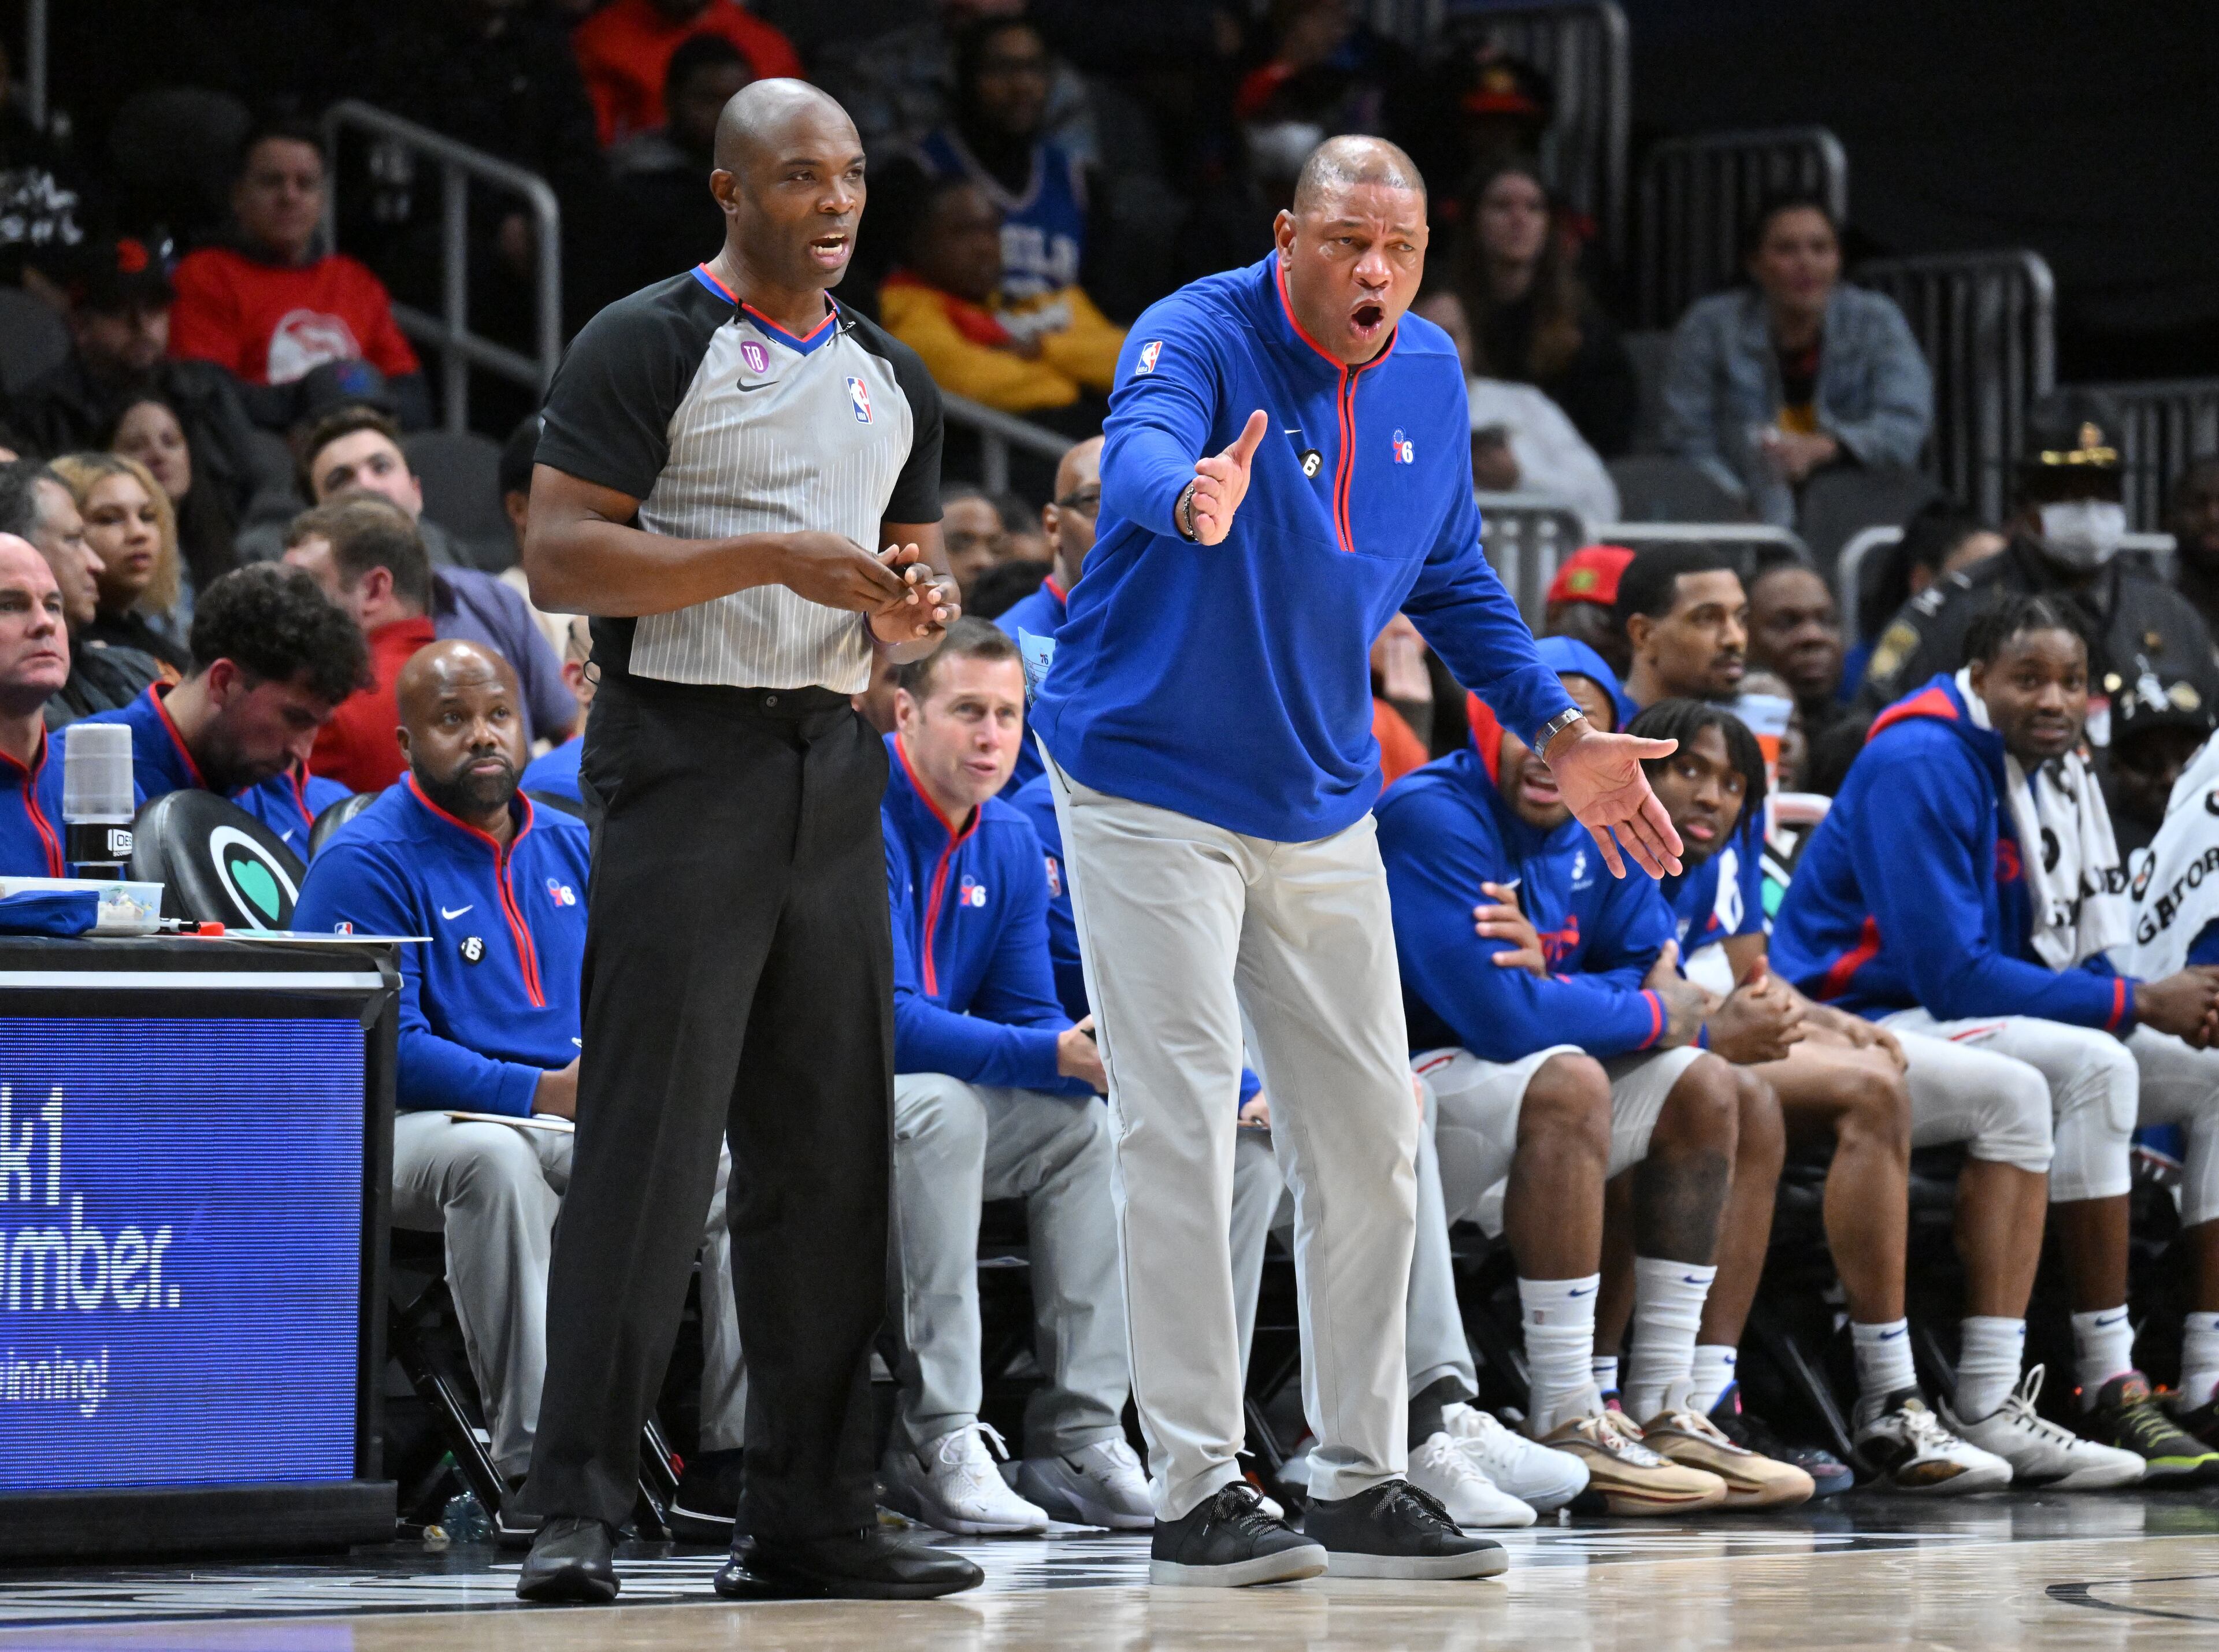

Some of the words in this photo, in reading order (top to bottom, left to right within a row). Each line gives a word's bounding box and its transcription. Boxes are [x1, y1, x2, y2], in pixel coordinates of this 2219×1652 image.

[743, 345, 764, 370] TB
[856, 411, 867, 421] NBA
[1393, 440, 1413, 463] 76
[1303, 452, 1320, 477] 6
[1040, 654, 1049, 665] 76
[960, 885, 986, 907] 76
[465, 936, 483, 961] 6
[0, 1191, 180, 1311] mber.
[0, 1345, 109, 1418] inning!
